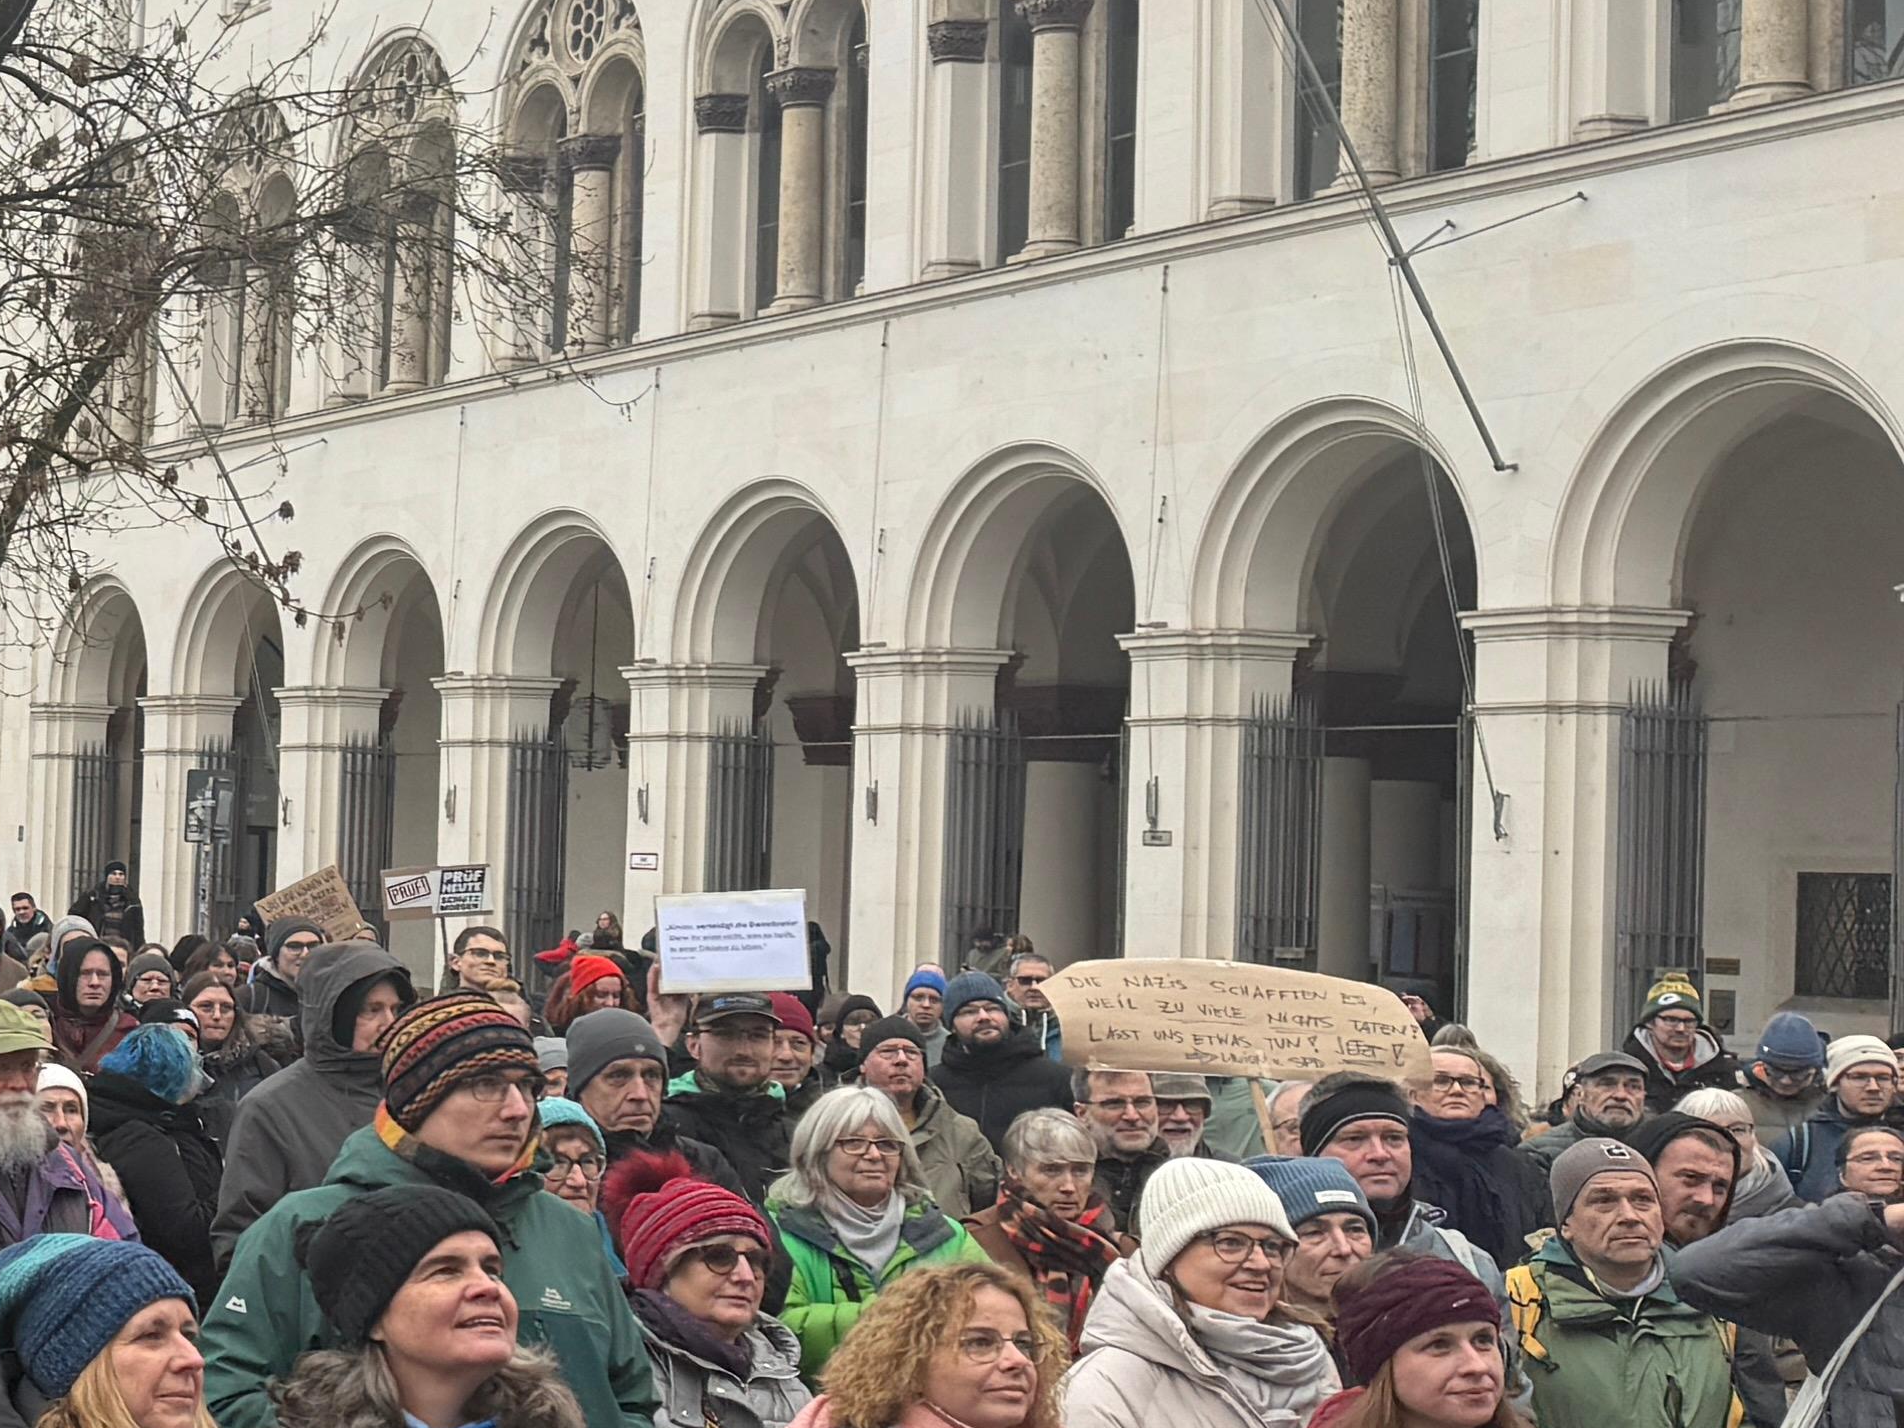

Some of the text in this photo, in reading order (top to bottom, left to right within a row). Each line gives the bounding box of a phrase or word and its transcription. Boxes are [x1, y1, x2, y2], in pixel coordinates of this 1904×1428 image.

[441, 882, 482, 893] HEUTE
[1064, 976, 1103, 989] DIE
[1209, 979, 1327, 1000] SCHAFFTEN
[1155, 1000, 1185, 1014] ZU
[1088, 1023, 1142, 1043] LASST
[1153, 1030, 1184, 1044] UNS
[1192, 1033, 1252, 1049] ETWAS
[1287, 1057, 1325, 1068] SPD
